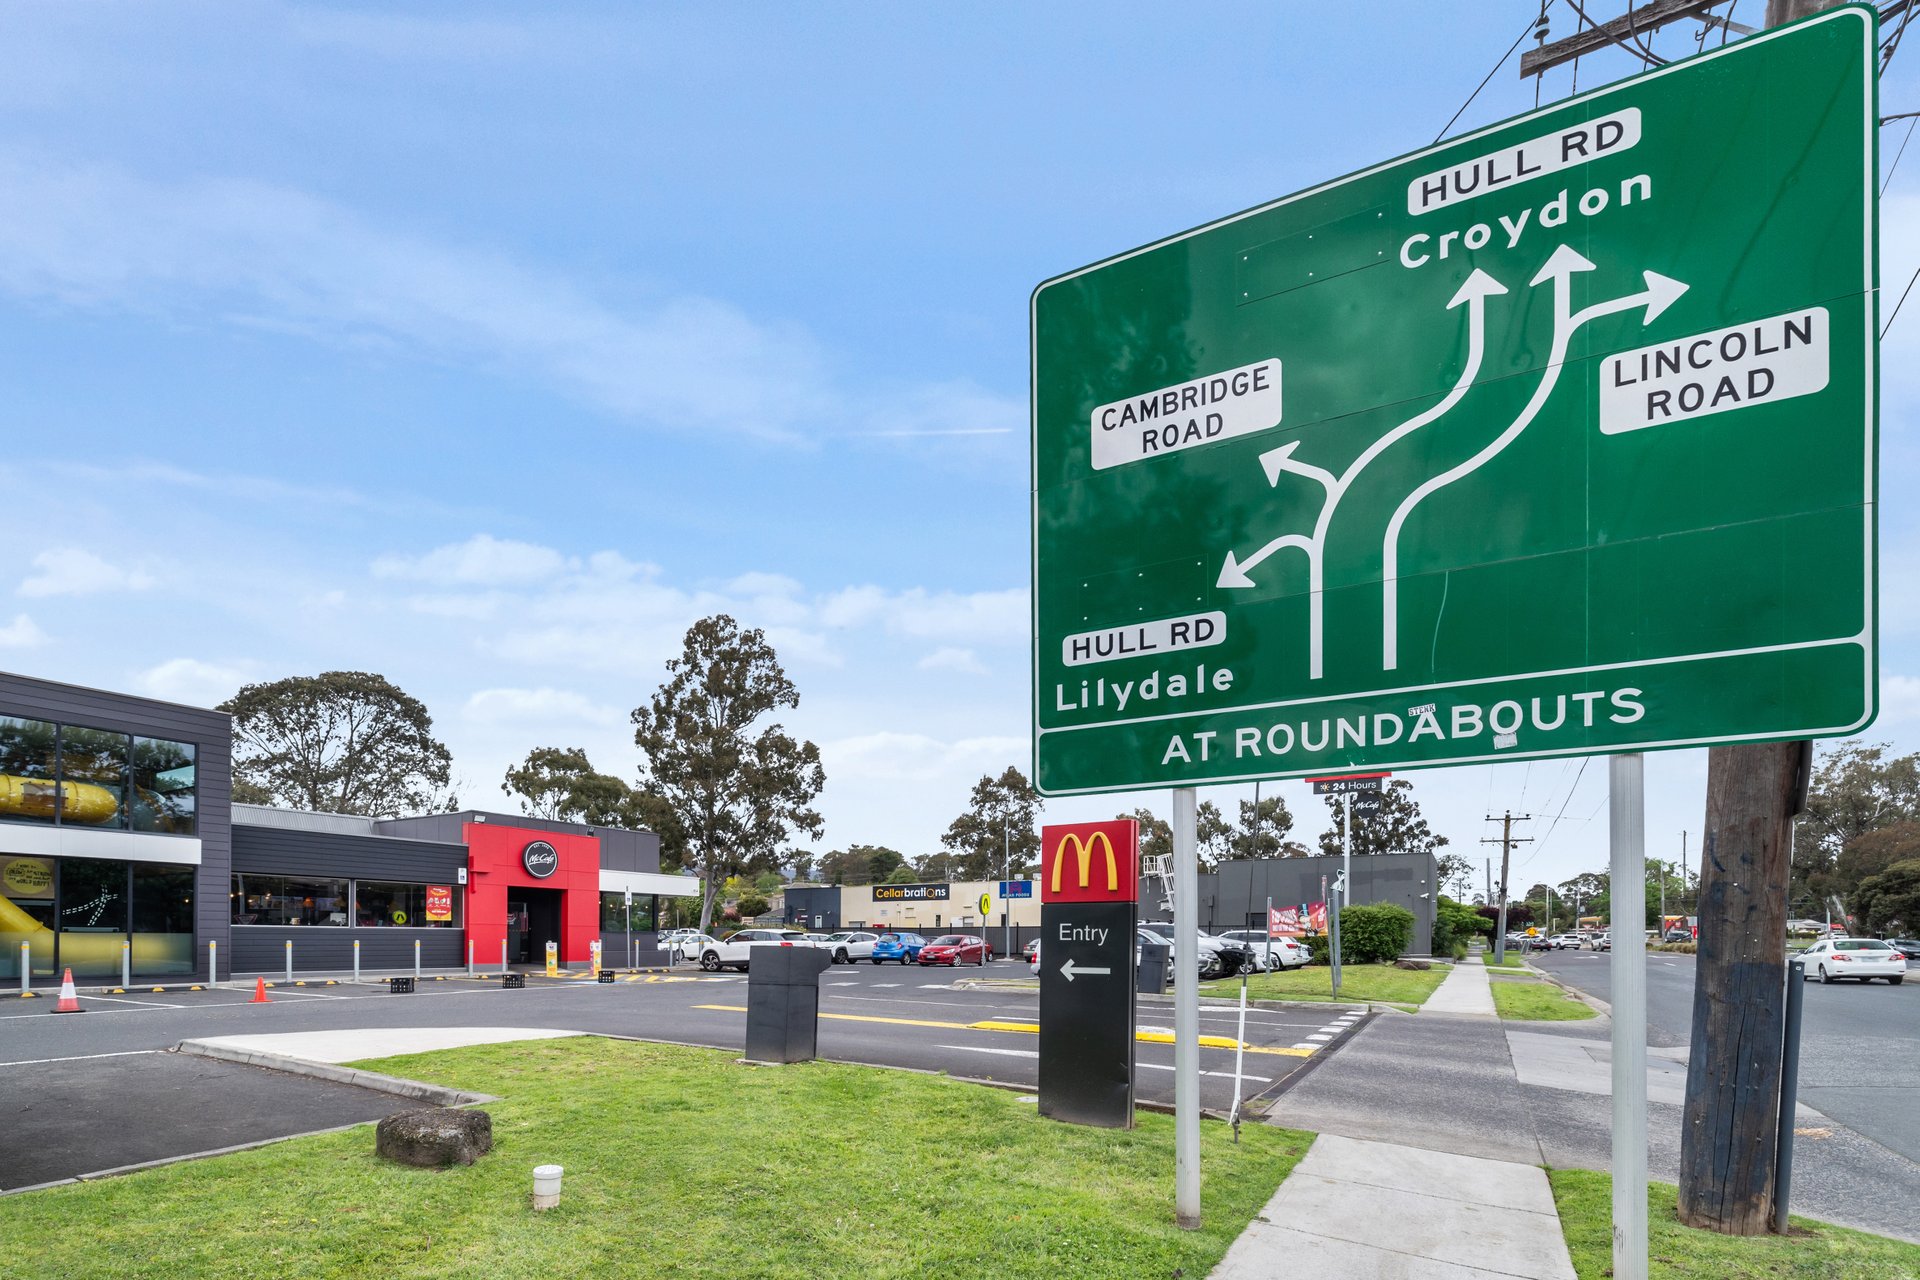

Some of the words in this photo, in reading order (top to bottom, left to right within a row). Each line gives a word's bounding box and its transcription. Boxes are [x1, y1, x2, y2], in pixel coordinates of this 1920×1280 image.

[1422, 149, 1542, 208] HULL
[1561, 120, 1624, 163] RD
[1399, 174, 1651, 269] Croydon
[1614, 315, 1812, 388] LINCOLN
[1101, 365, 1270, 432] CAMBRIDGE
[1647, 367, 1775, 421] ROAD
[1142, 412, 1223, 454] ROAD
[1072, 627, 1157, 661] HULL
[1170, 618, 1215, 646] RD
[1056, 664, 1234, 711] Lilydale
[1161, 731, 1217, 765] AT
[1235, 687, 1645, 758] ROUNDABOUTS
[1332, 782, 1346, 791] 24
[1348, 781, 1377, 790] Hours
[1059, 923, 1109, 947] Entry
